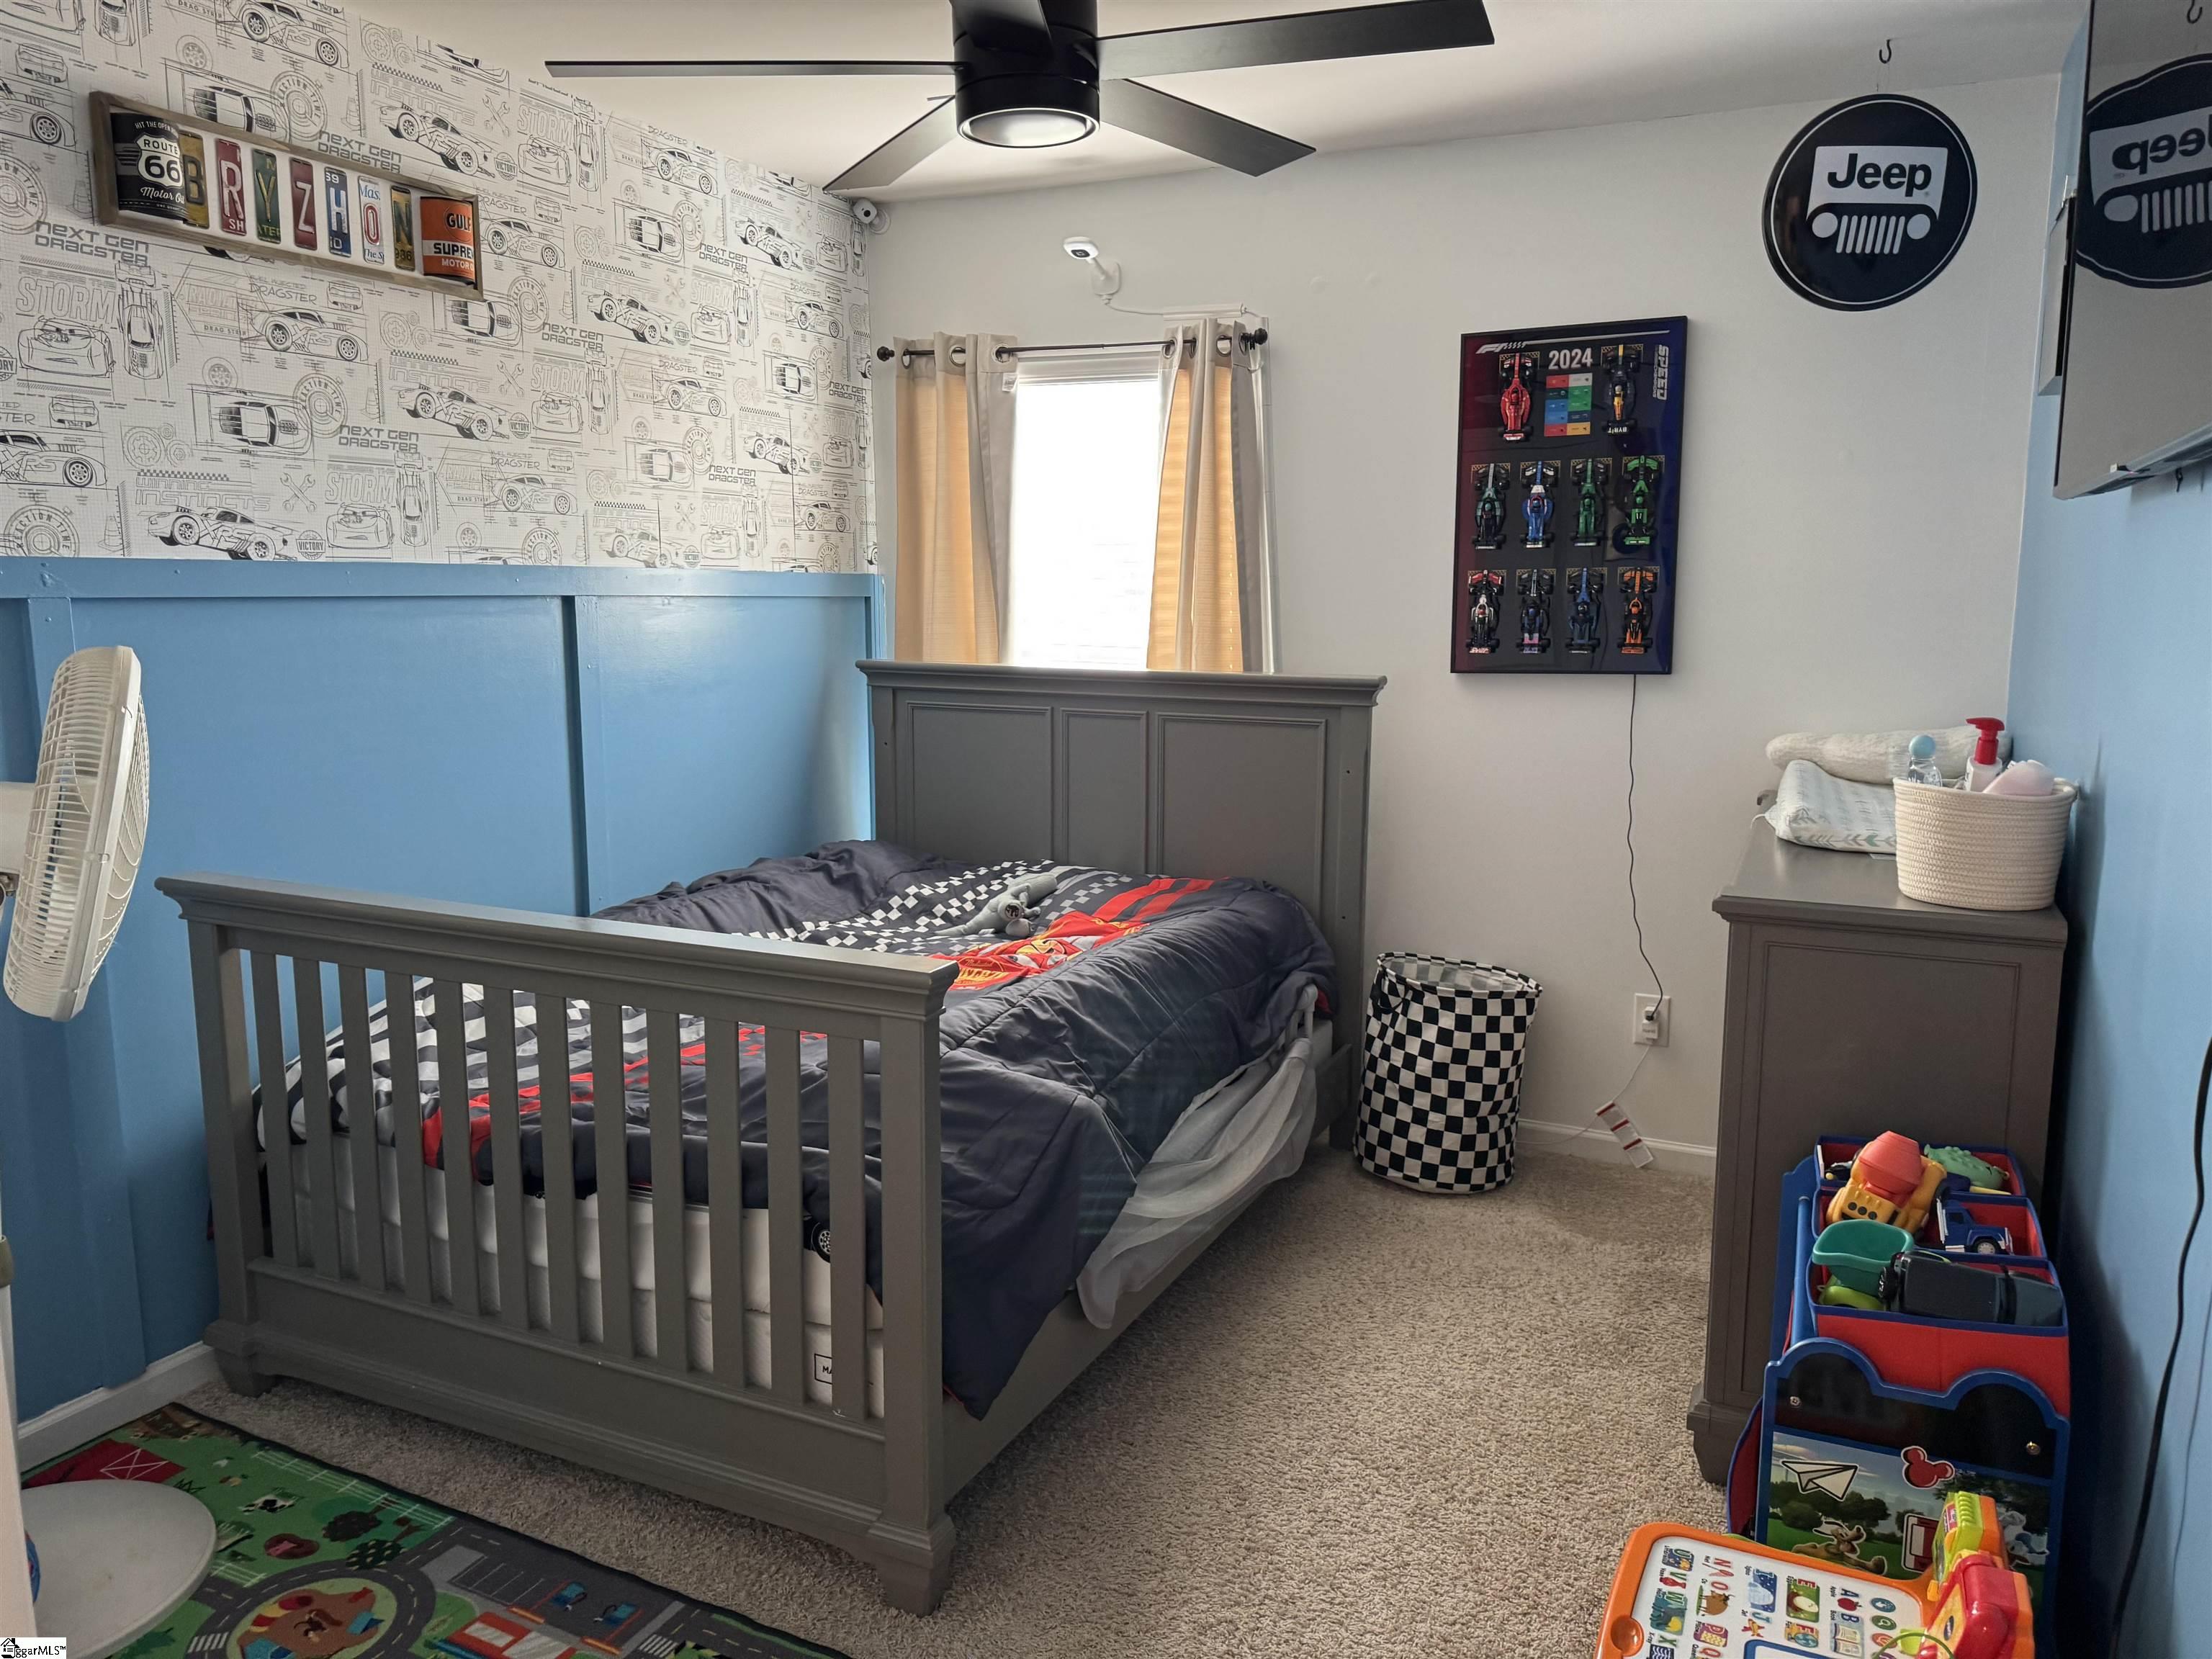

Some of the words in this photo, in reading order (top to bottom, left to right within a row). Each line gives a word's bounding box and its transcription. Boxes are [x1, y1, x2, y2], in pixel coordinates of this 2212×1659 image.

[143, 139, 179, 155] ROUTE
[145, 155, 181, 184] 66
[496, 161, 516, 174] VICTORY
[1827, 153, 1932, 197] Jeep
[140, 186, 174, 201] Motor
[441, 258, 469, 269] MOTOR
[16, 276, 117, 323] STORM
[248, 282, 317, 305] DRAGSTER
[1548, 347, 1593, 369] 2024
[531, 363, 585, 395] STORM
[1656, 344, 1669, 400] SPEED
[511, 421, 529, 431] VICTORY
[491, 457, 540, 470] DRAGSTER
[325, 472, 395, 504] STORM
[299, 540, 323, 551] VICTORY
[1840, 1588, 1860, 1598] A
